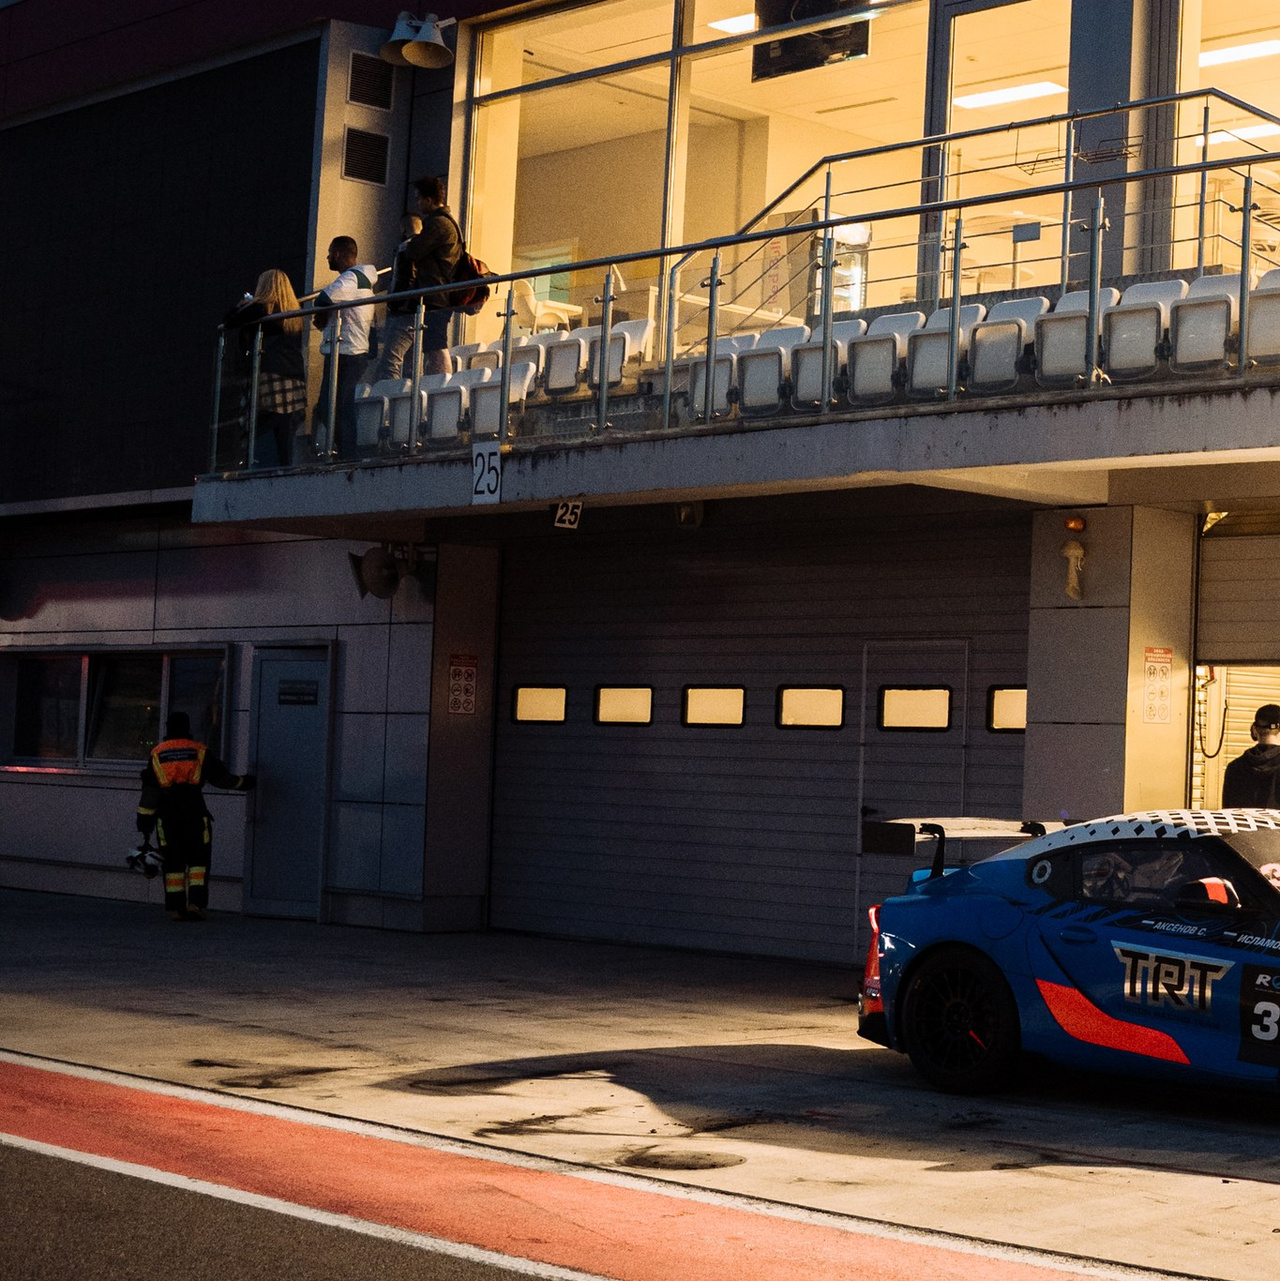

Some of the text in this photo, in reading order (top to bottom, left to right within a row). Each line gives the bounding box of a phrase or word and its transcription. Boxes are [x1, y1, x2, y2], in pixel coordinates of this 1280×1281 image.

[474, 451, 499, 495] 25
[556, 503, 580, 525] 25
[1153, 921, 1197, 935] АКСЕНОВ
[1110, 940, 1236, 1013] TRT
